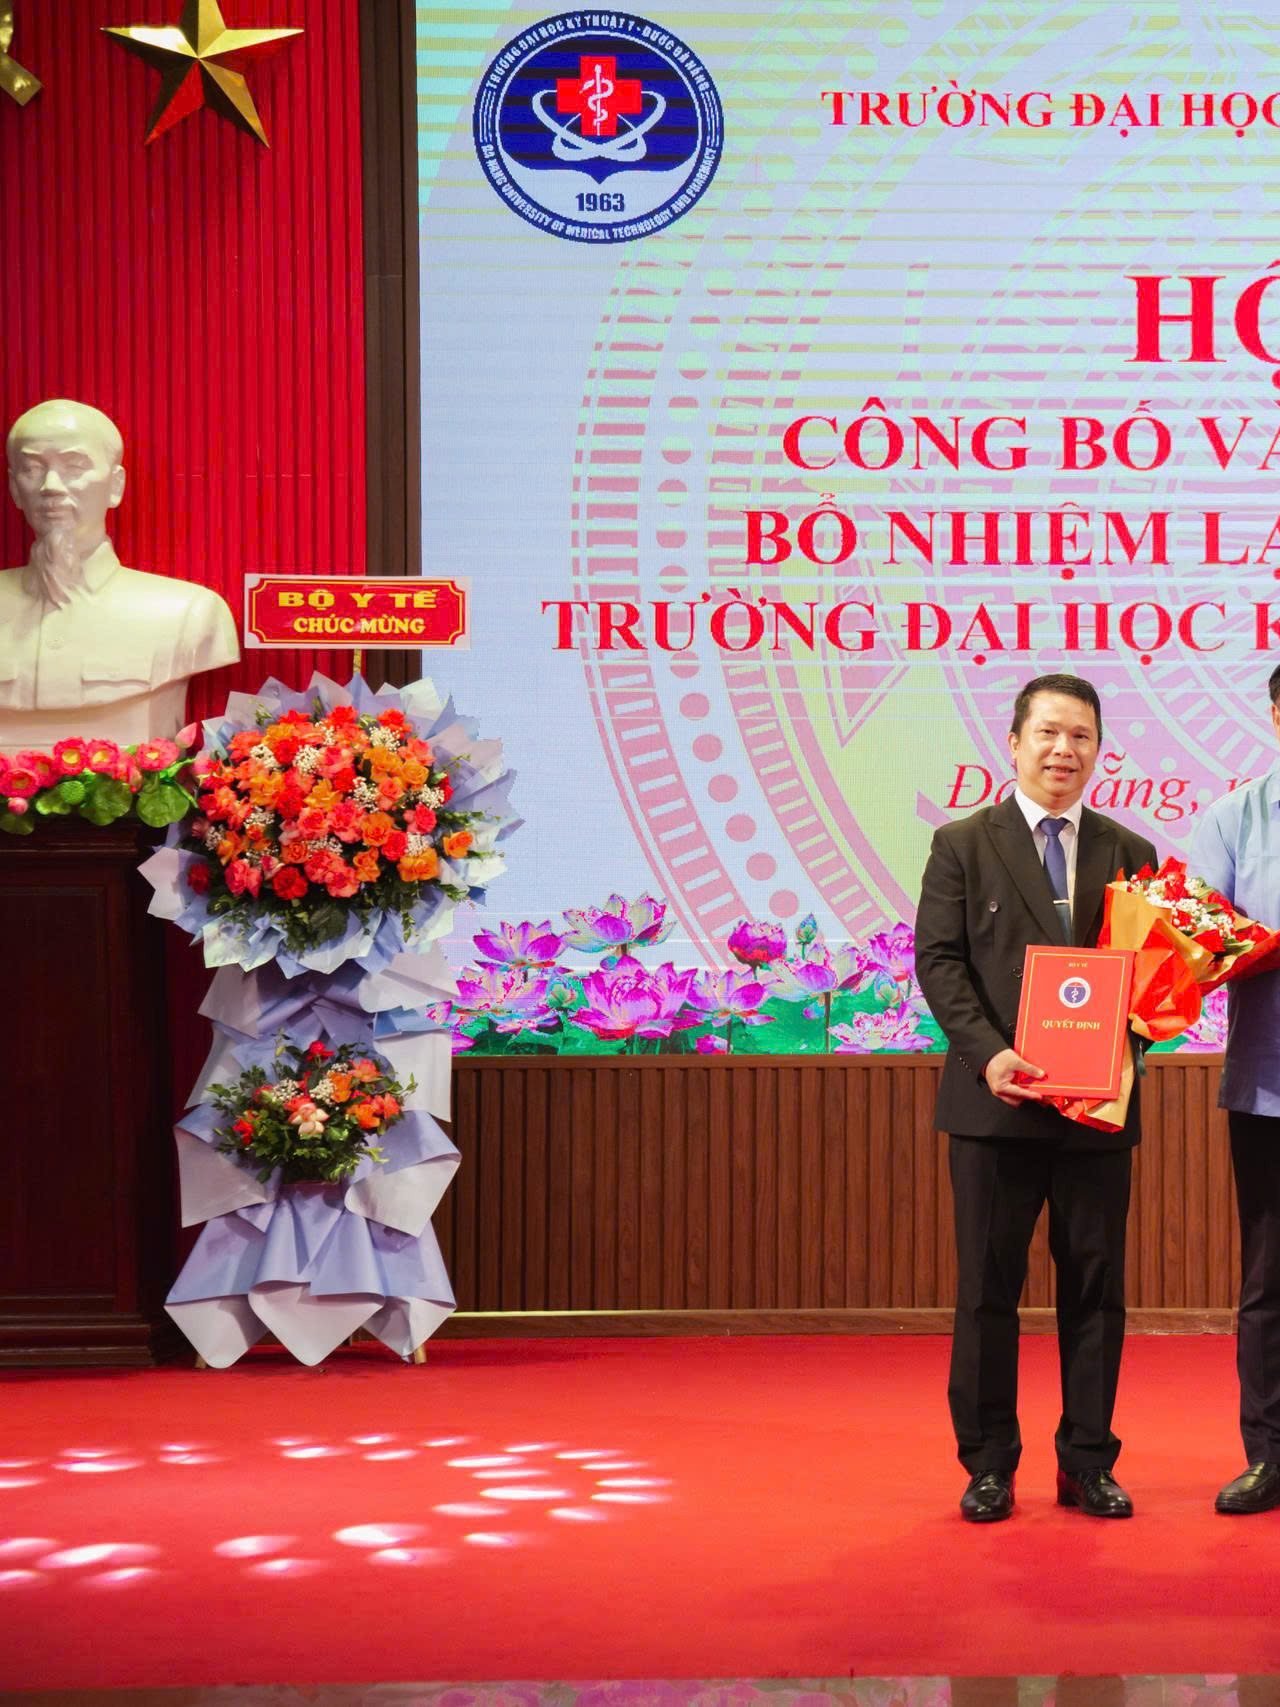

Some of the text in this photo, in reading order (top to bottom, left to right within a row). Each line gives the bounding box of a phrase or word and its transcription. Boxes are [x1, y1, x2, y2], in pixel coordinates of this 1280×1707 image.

[821, 80, 1053, 128] TRƯỜNG
[1069, 92, 1162, 137] ĐẠI
[575, 193, 625, 212] 1963
[782, 396, 1029, 472] CÔNG
[1061, 400, 1173, 472] BỐ
[743, 492, 858, 567] BỔ
[882, 503, 1171, 581] NHIỆM
[278, 588, 441, 611] BỘ Y TẾ
[293, 613, 426, 635] CHÚC MỪNG
[541, 588, 877, 653] TRƯỜNG
[900, 601, 1031, 666] ĐẠI
[1063, 600, 1227, 666] HỌC
[1090, 751, 1199, 822] ẵng,
[1042, 1018, 1100, 1031] QUYẾT ĐỊNH
